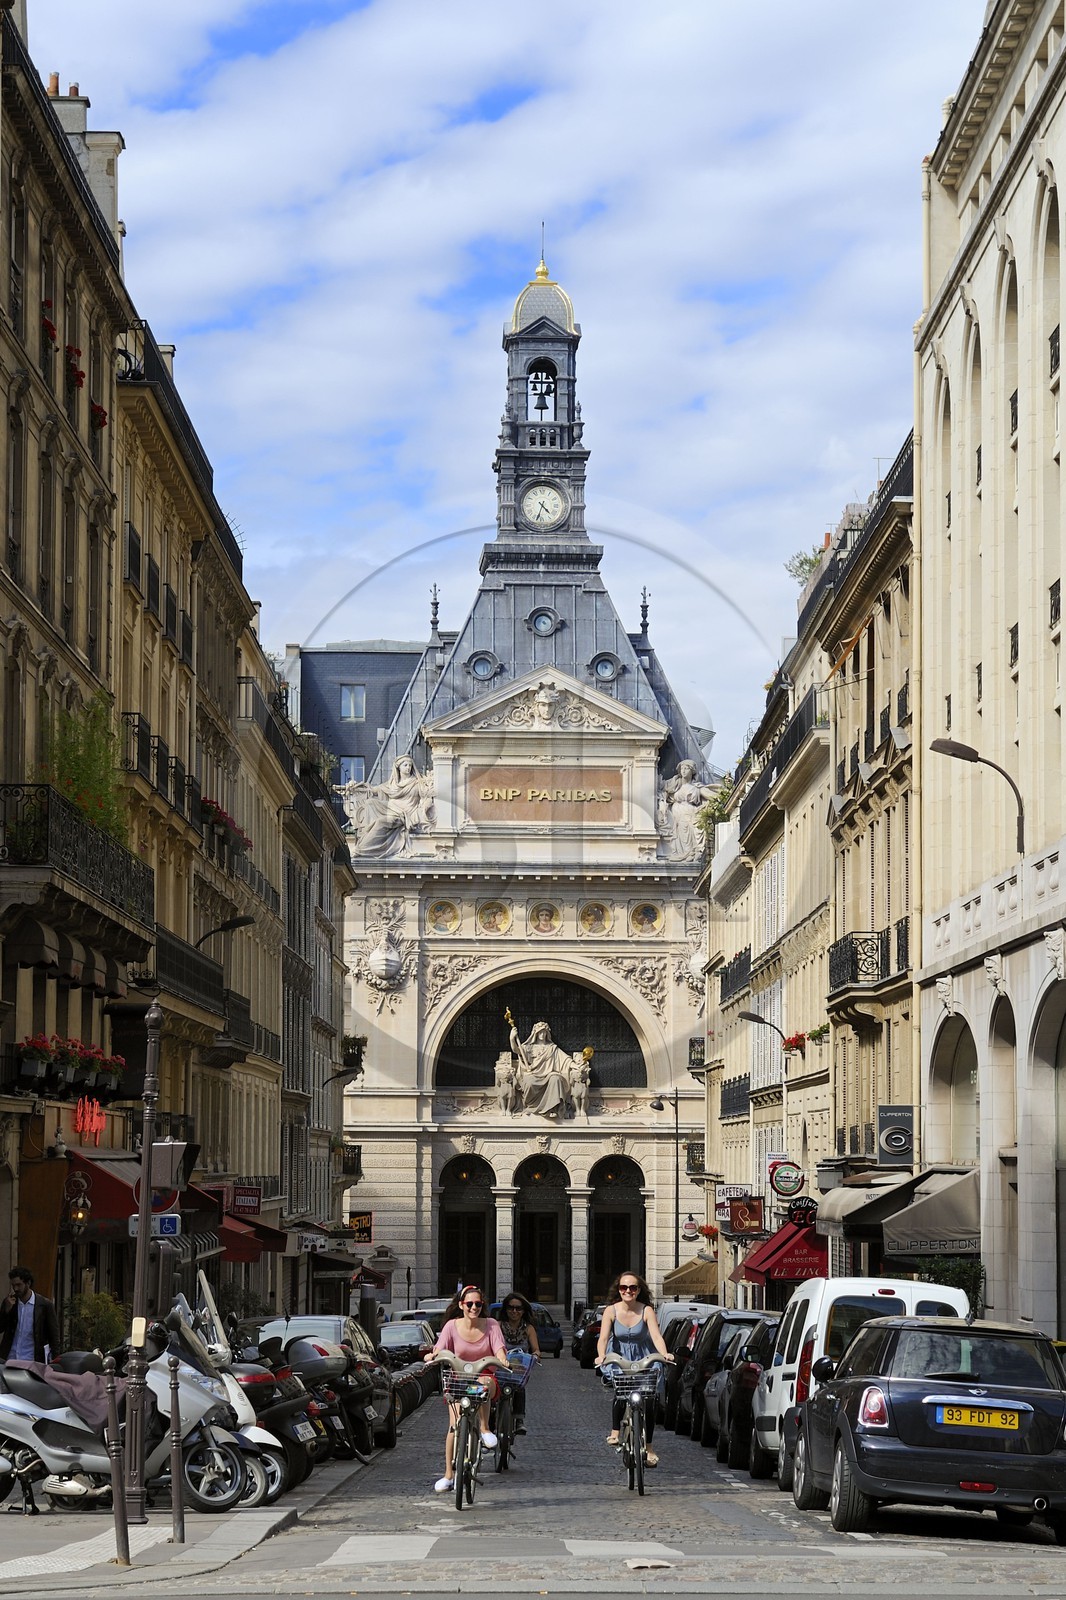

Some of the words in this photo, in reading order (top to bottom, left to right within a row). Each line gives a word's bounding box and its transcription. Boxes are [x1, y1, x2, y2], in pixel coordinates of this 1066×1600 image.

[479, 787, 522, 802] BNP
[527, 788, 612, 803] PARIBAS
[887, 1239, 978, 1251] CLIPPERTON
[782, 1256, 820, 1264] BRASSERIE
[773, 1267, 790, 1277] LE
[795, 1267, 822, 1277] ZINC
[946, 1408, 963, 1422] 93
[969, 1410, 993, 1424] FDT
[1000, 1413, 1016, 1426] 92
